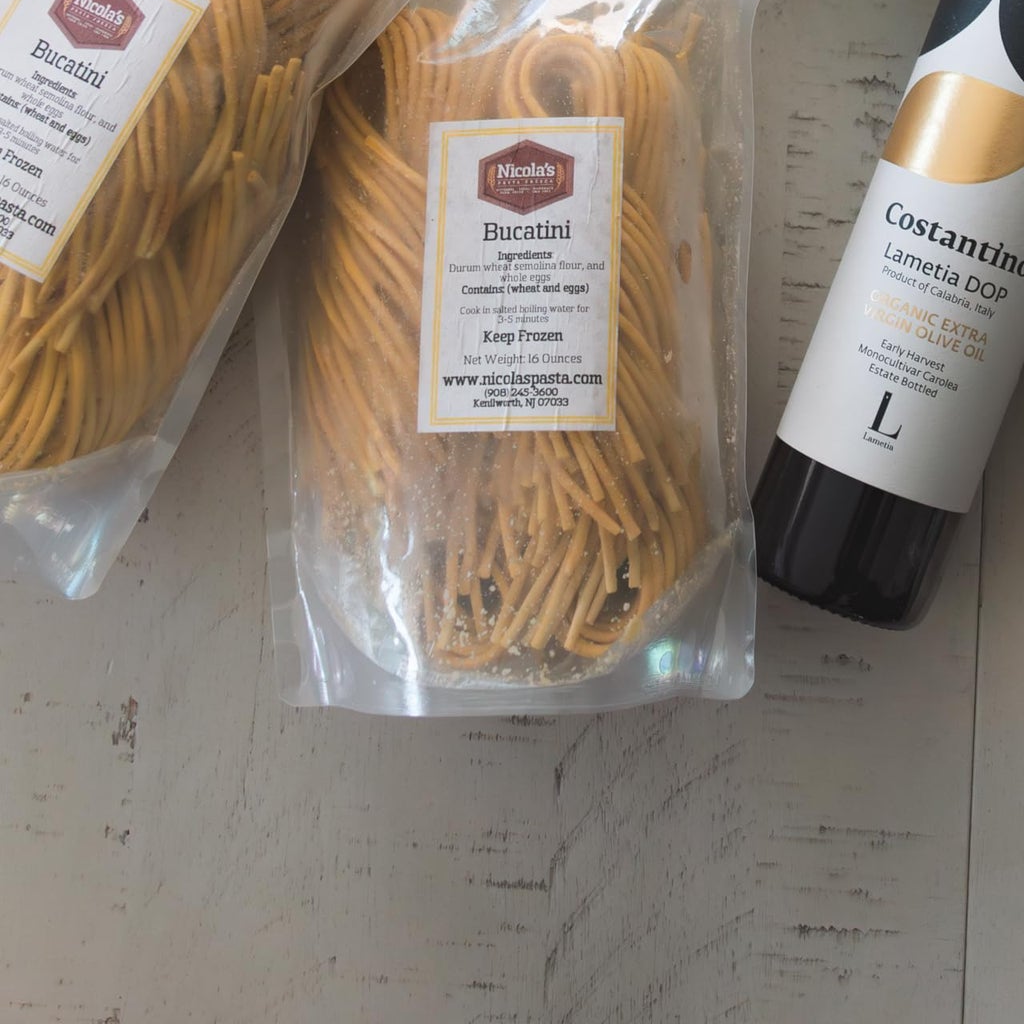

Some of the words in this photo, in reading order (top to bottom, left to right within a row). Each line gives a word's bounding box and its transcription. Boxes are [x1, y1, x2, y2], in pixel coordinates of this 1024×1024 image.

[30, 39, 108, 89] Bucatini
[14, 76, 41, 93] wheat
[38, 88, 74, 111] semolina
[74, 105, 96, 124] flour,
[98, 119, 118, 133] and
[21, 92, 45, 109] whole
[44, 104, 64, 119] eggs
[20, 103, 51, 124] (wheat
[48, 119, 67, 133] and
[66, 128, 91, 147] eggs)
[2, 149, 43, 179] Frozen
[44, 141, 68, 157] water
[66, 152, 81, 164] for
[497, 162, 556, 178] Nicola's
[11, 182, 48, 207] Ounces
[0, 197, 56, 236] asta.com
[483, 220, 571, 241] Bucatini
[449, 263, 481, 273] Durum
[483, 261, 512, 272] wheat
[513, 260, 557, 271] semolina
[559, 260, 585, 271] flour,
[586, 260, 605, 271] and
[499, 272, 527, 283] whole
[529, 274, 551, 284] eggs
[884, 242, 960, 287] Lametia
[964, 275, 1008, 302] DOP
[507, 282, 541, 295] (wheat
[542, 282, 561, 293] and
[563, 283, 589, 295] eggs)
[882, 265, 917, 288] Product
[918, 282, 931, 294] of
[930, 286, 972, 311] Calabria,
[974, 303, 995, 320] Italy
[459, 305, 481, 315] Cook
[482, 305, 491, 314] in
[492, 304, 517, 314] salted
[519, 304, 548, 315] boiling
[549, 305, 575, 313] water
[577, 304, 590, 313] for
[515, 313, 549, 324] minutes
[870, 289, 940, 326] ORGANIC
[940, 318, 987, 345] EXTRA
[483, 330, 515, 346] Keep
[518, 329, 563, 342] Frozen
[864, 306, 913, 335] VIRGIN
[916, 326, 962, 353] OLIVE
[963, 344, 984, 362] OIL
[464, 355, 482, 365] Net
[528, 353, 540, 364] 16
[542, 353, 582, 364] Ounces
[858, 343, 922, 377] Monocultivar
[922, 371, 958, 391] Carolea
[880, 339, 906, 357] Early
[906, 349, 945, 373] Harvest
[442, 371, 603, 389] www.nicolaspasta.com
[510, 387, 559, 397] 245-3600
[868, 363, 900, 383] Estate
[901, 377, 938, 398] Bottled
[473, 398, 523, 408] Kenilworth,
[525, 397, 536, 409] NJ
[537, 397, 569, 407] 07033
[867, 390, 902, 440] L
[863, 431, 894, 451] Lametia
